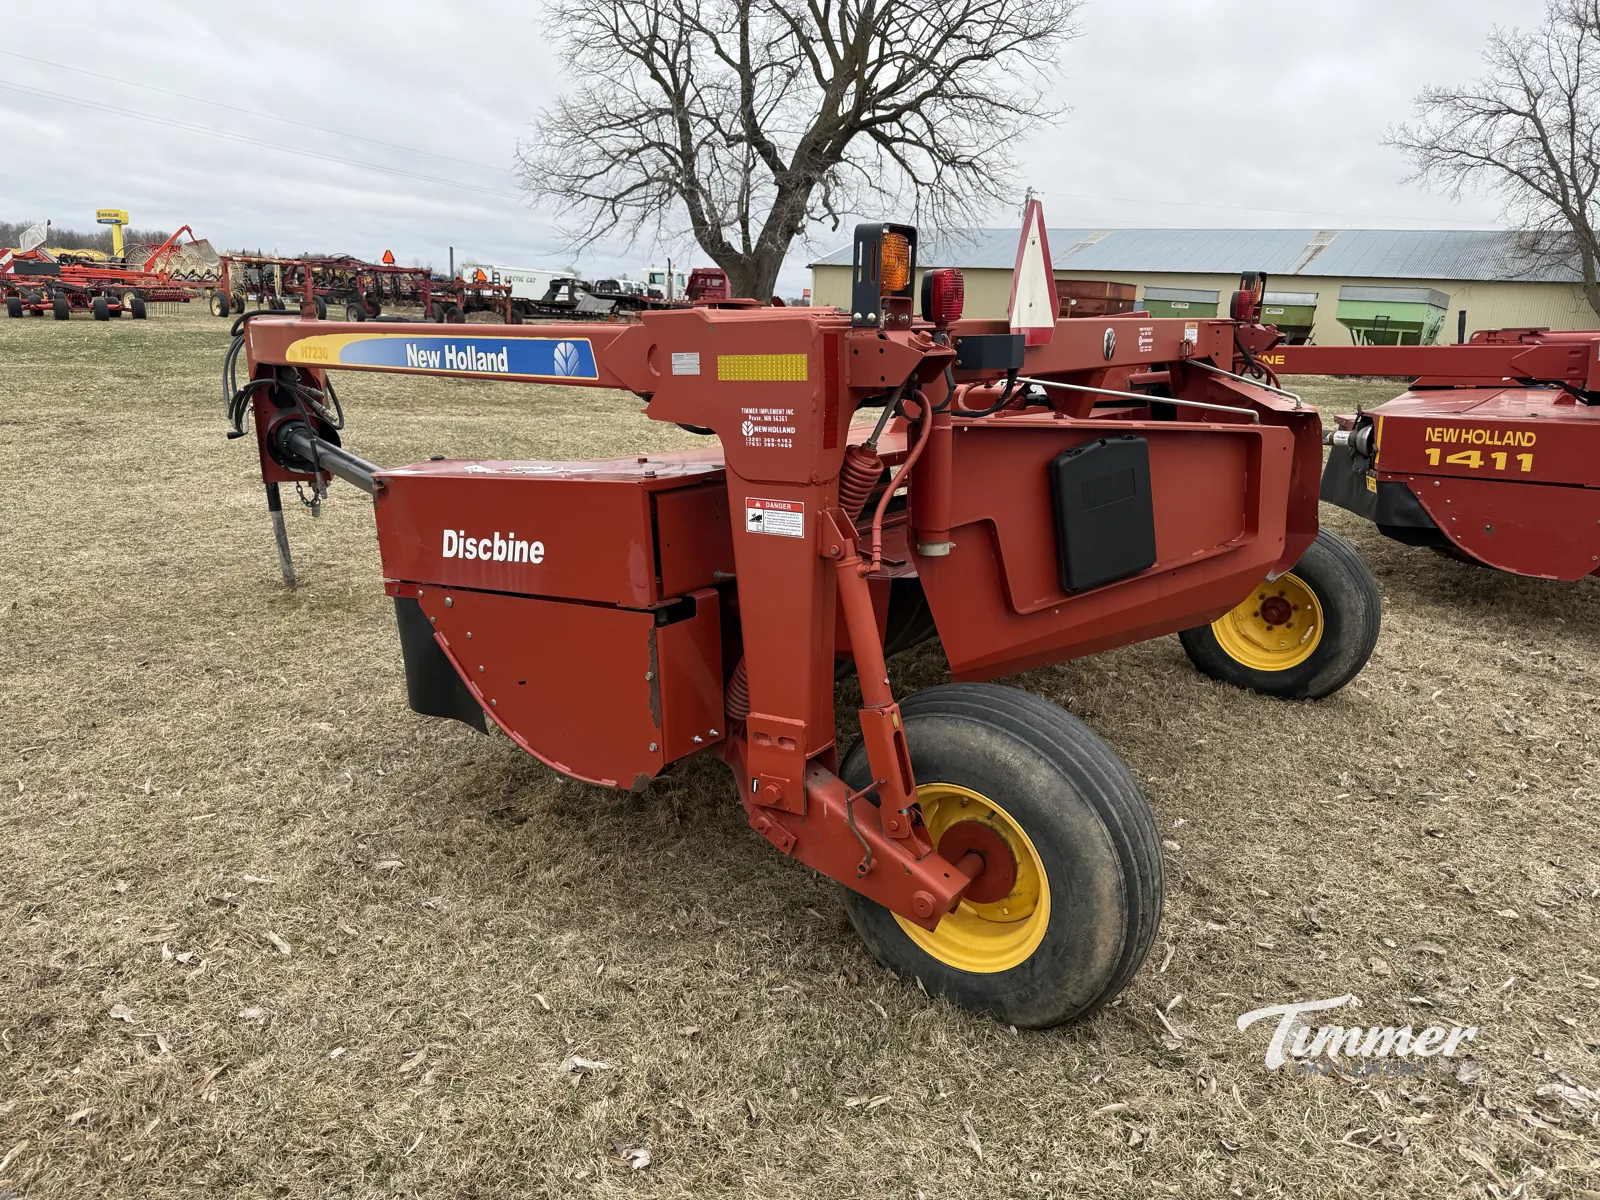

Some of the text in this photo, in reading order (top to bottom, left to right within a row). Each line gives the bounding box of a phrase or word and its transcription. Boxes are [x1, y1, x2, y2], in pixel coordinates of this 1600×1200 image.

[300, 345, 329, 361] H7230
[405, 343, 509, 372] New Holland
[1262, 355, 1285, 365] NE
[768, 426, 796, 434] HOLLAND
[1425, 427, 1537, 447] NEW HOLLAND
[1425, 447, 1534, 472] 1411
[765, 501, 792, 510] DANGER
[442, 529, 545, 564] Discbine
